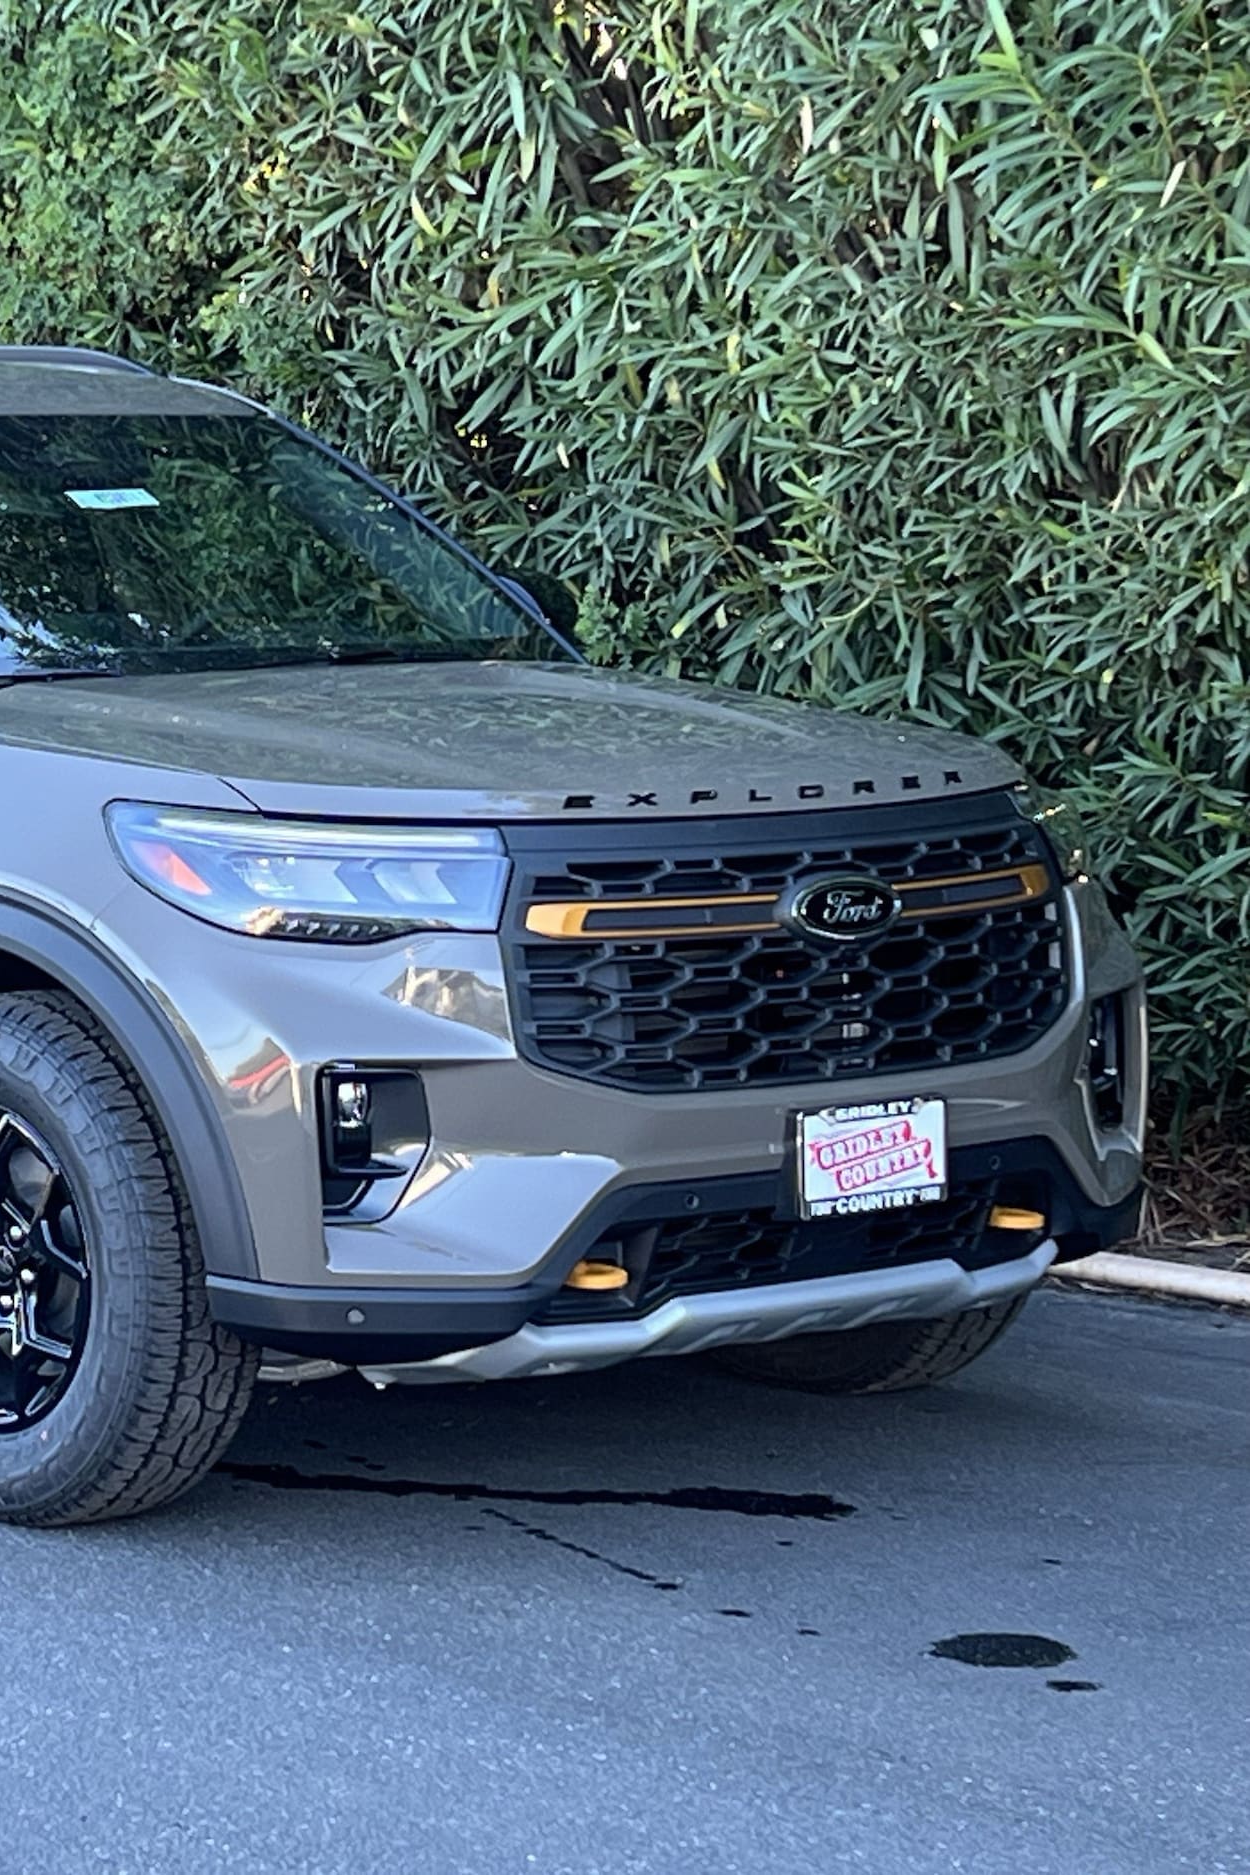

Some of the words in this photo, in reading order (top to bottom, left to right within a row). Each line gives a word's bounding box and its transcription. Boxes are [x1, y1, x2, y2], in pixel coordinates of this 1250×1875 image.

[563, 770, 963, 810] EXPLORER
[822, 890, 884, 924] Ford
[819, 1126, 906, 1167] GRIDLEY
[838, 1142, 929, 1190] COUNTRY
[836, 1188, 914, 1215] COUNTRY
